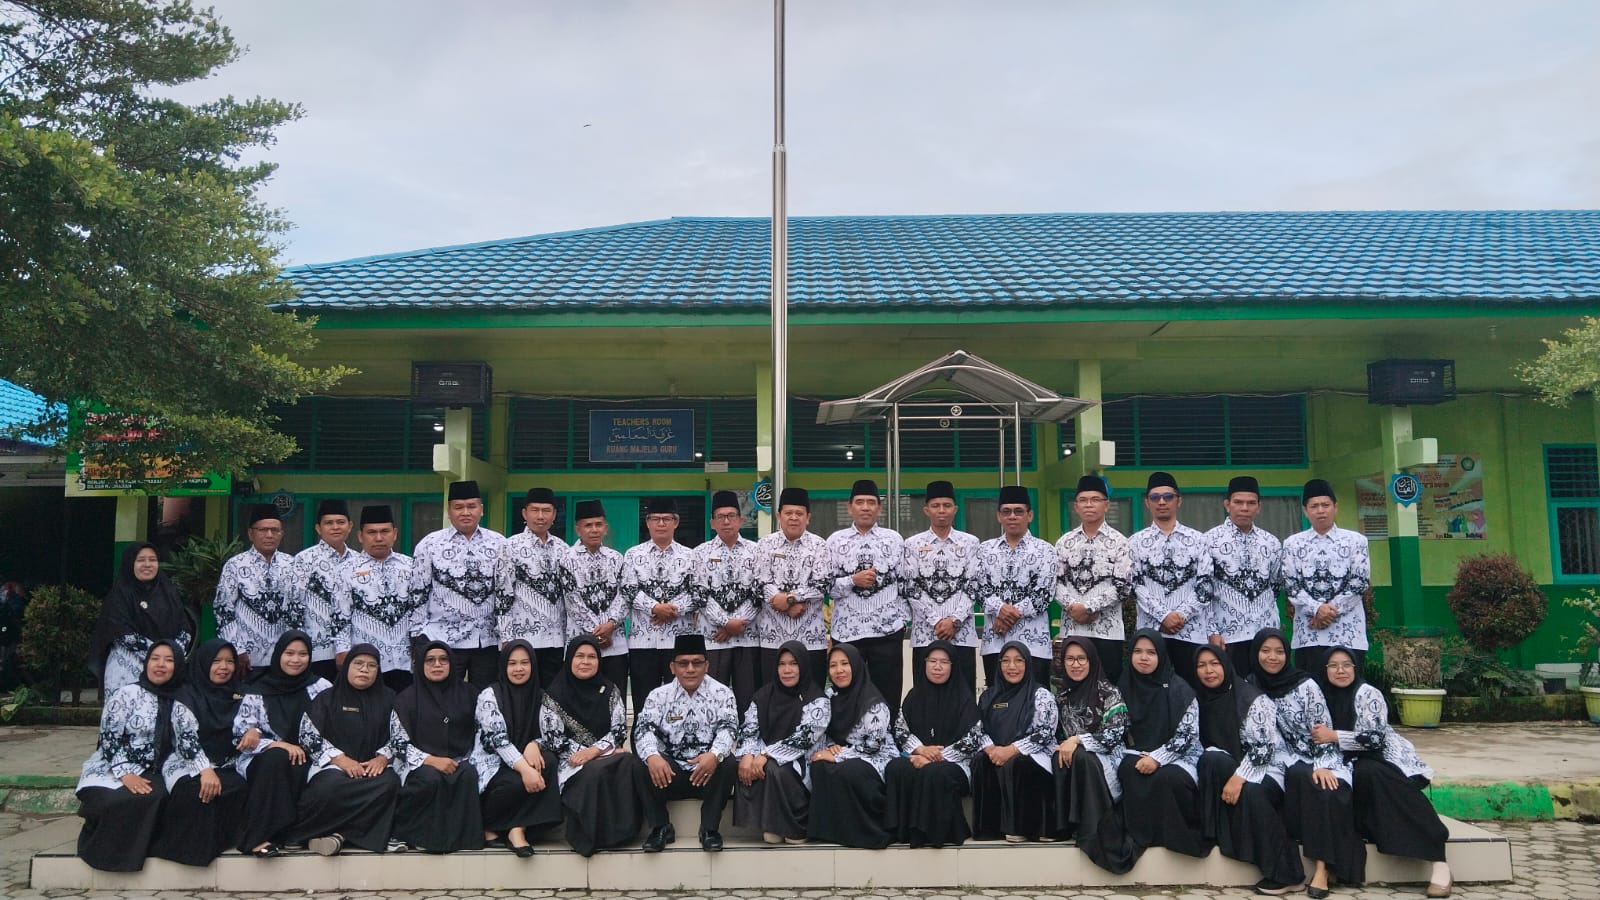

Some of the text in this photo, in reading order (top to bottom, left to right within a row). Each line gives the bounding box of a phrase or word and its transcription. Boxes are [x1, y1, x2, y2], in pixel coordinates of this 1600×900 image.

[612, 417, 672, 426] TEACHERS ROOM
[606, 445, 678, 454] RUANG MAJELIS GURU
